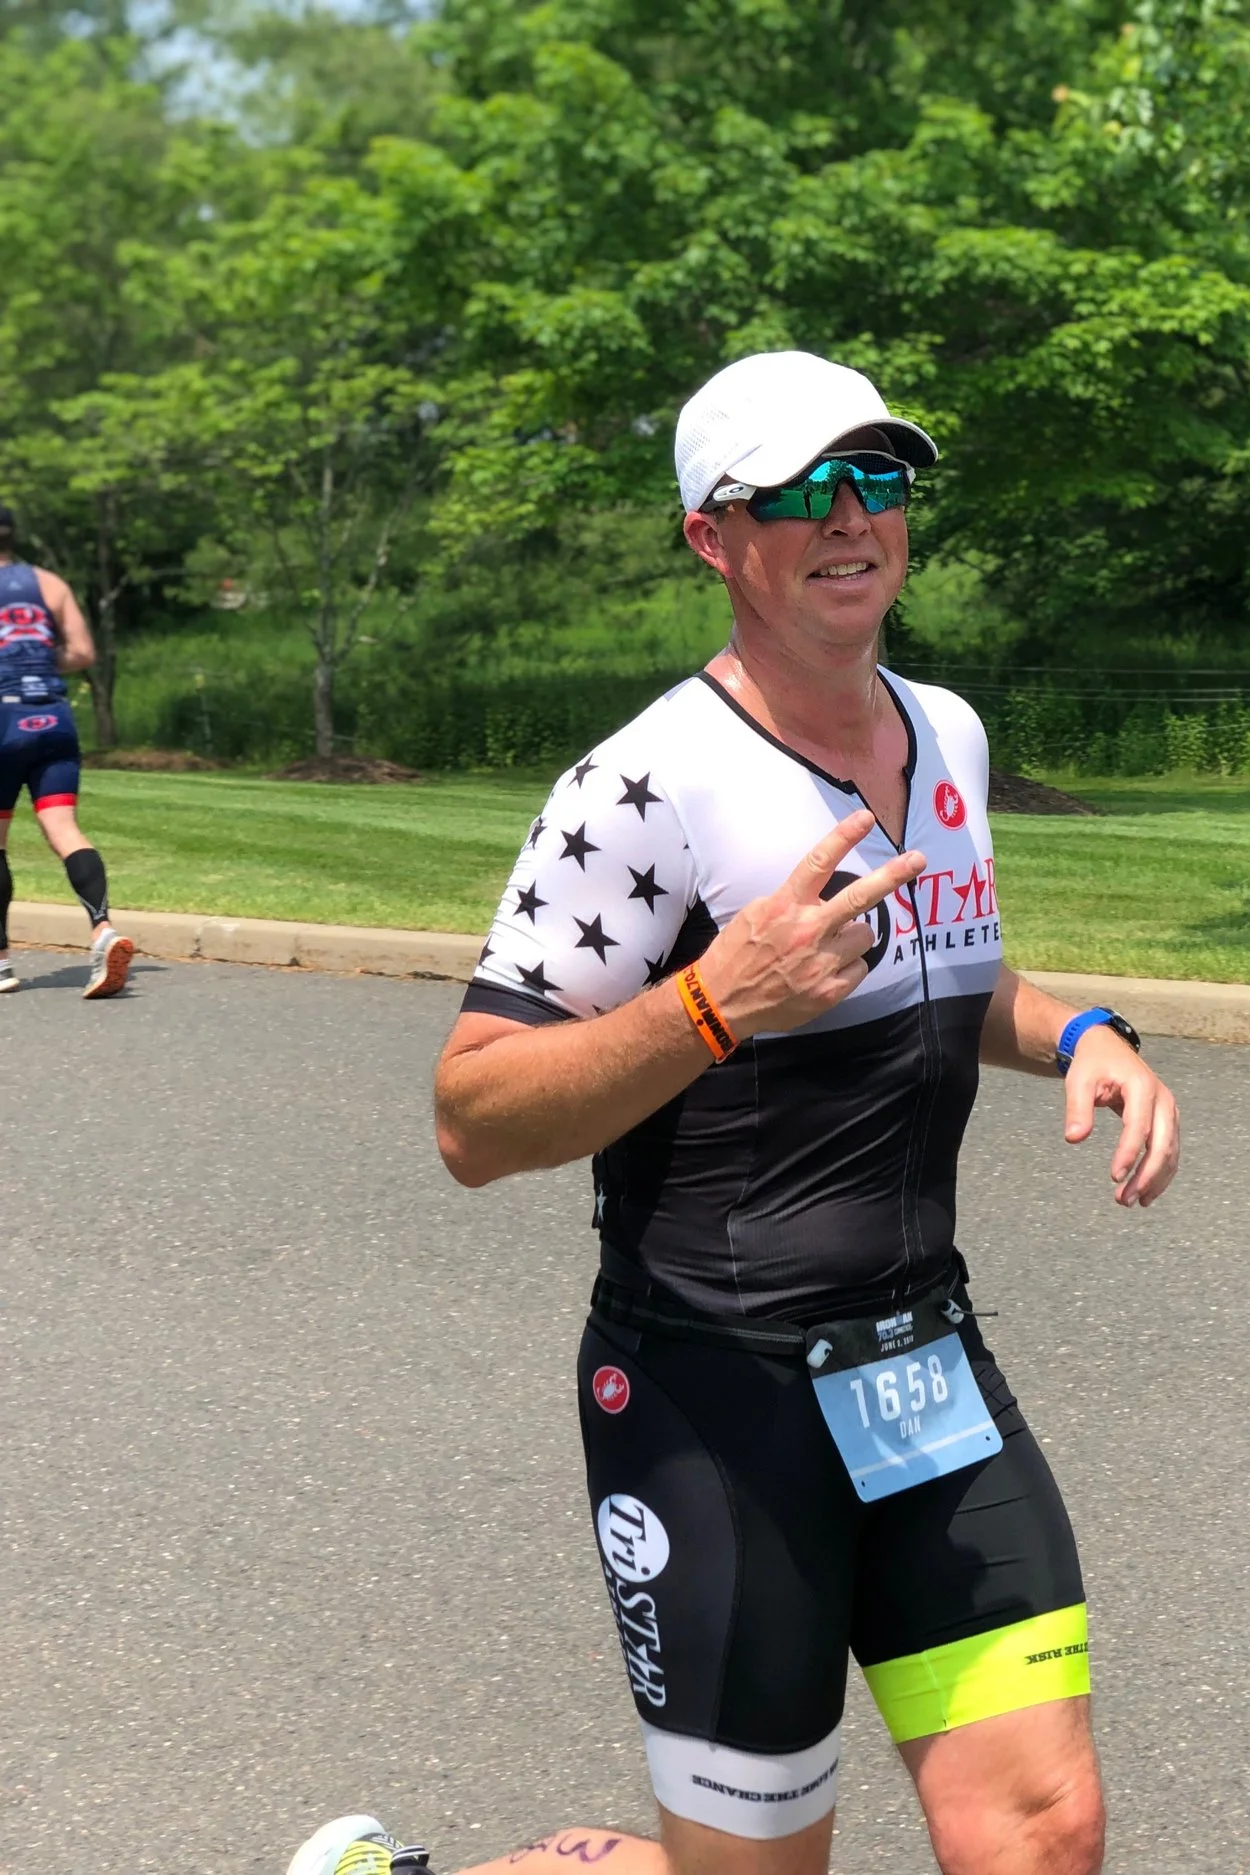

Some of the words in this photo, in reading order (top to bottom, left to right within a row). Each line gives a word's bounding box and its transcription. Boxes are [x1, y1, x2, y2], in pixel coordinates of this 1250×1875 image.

[850, 1355, 948, 1428] 1658
[900, 1415, 921, 1439] DAN
[609, 1495, 651, 1576] Tri
[616, 1577, 667, 1708] STAR
[1023, 1647, 1062, 1665] RISK
[692, 1774, 762, 1802] CHANCE
[764, 1789, 799, 1803] THE
